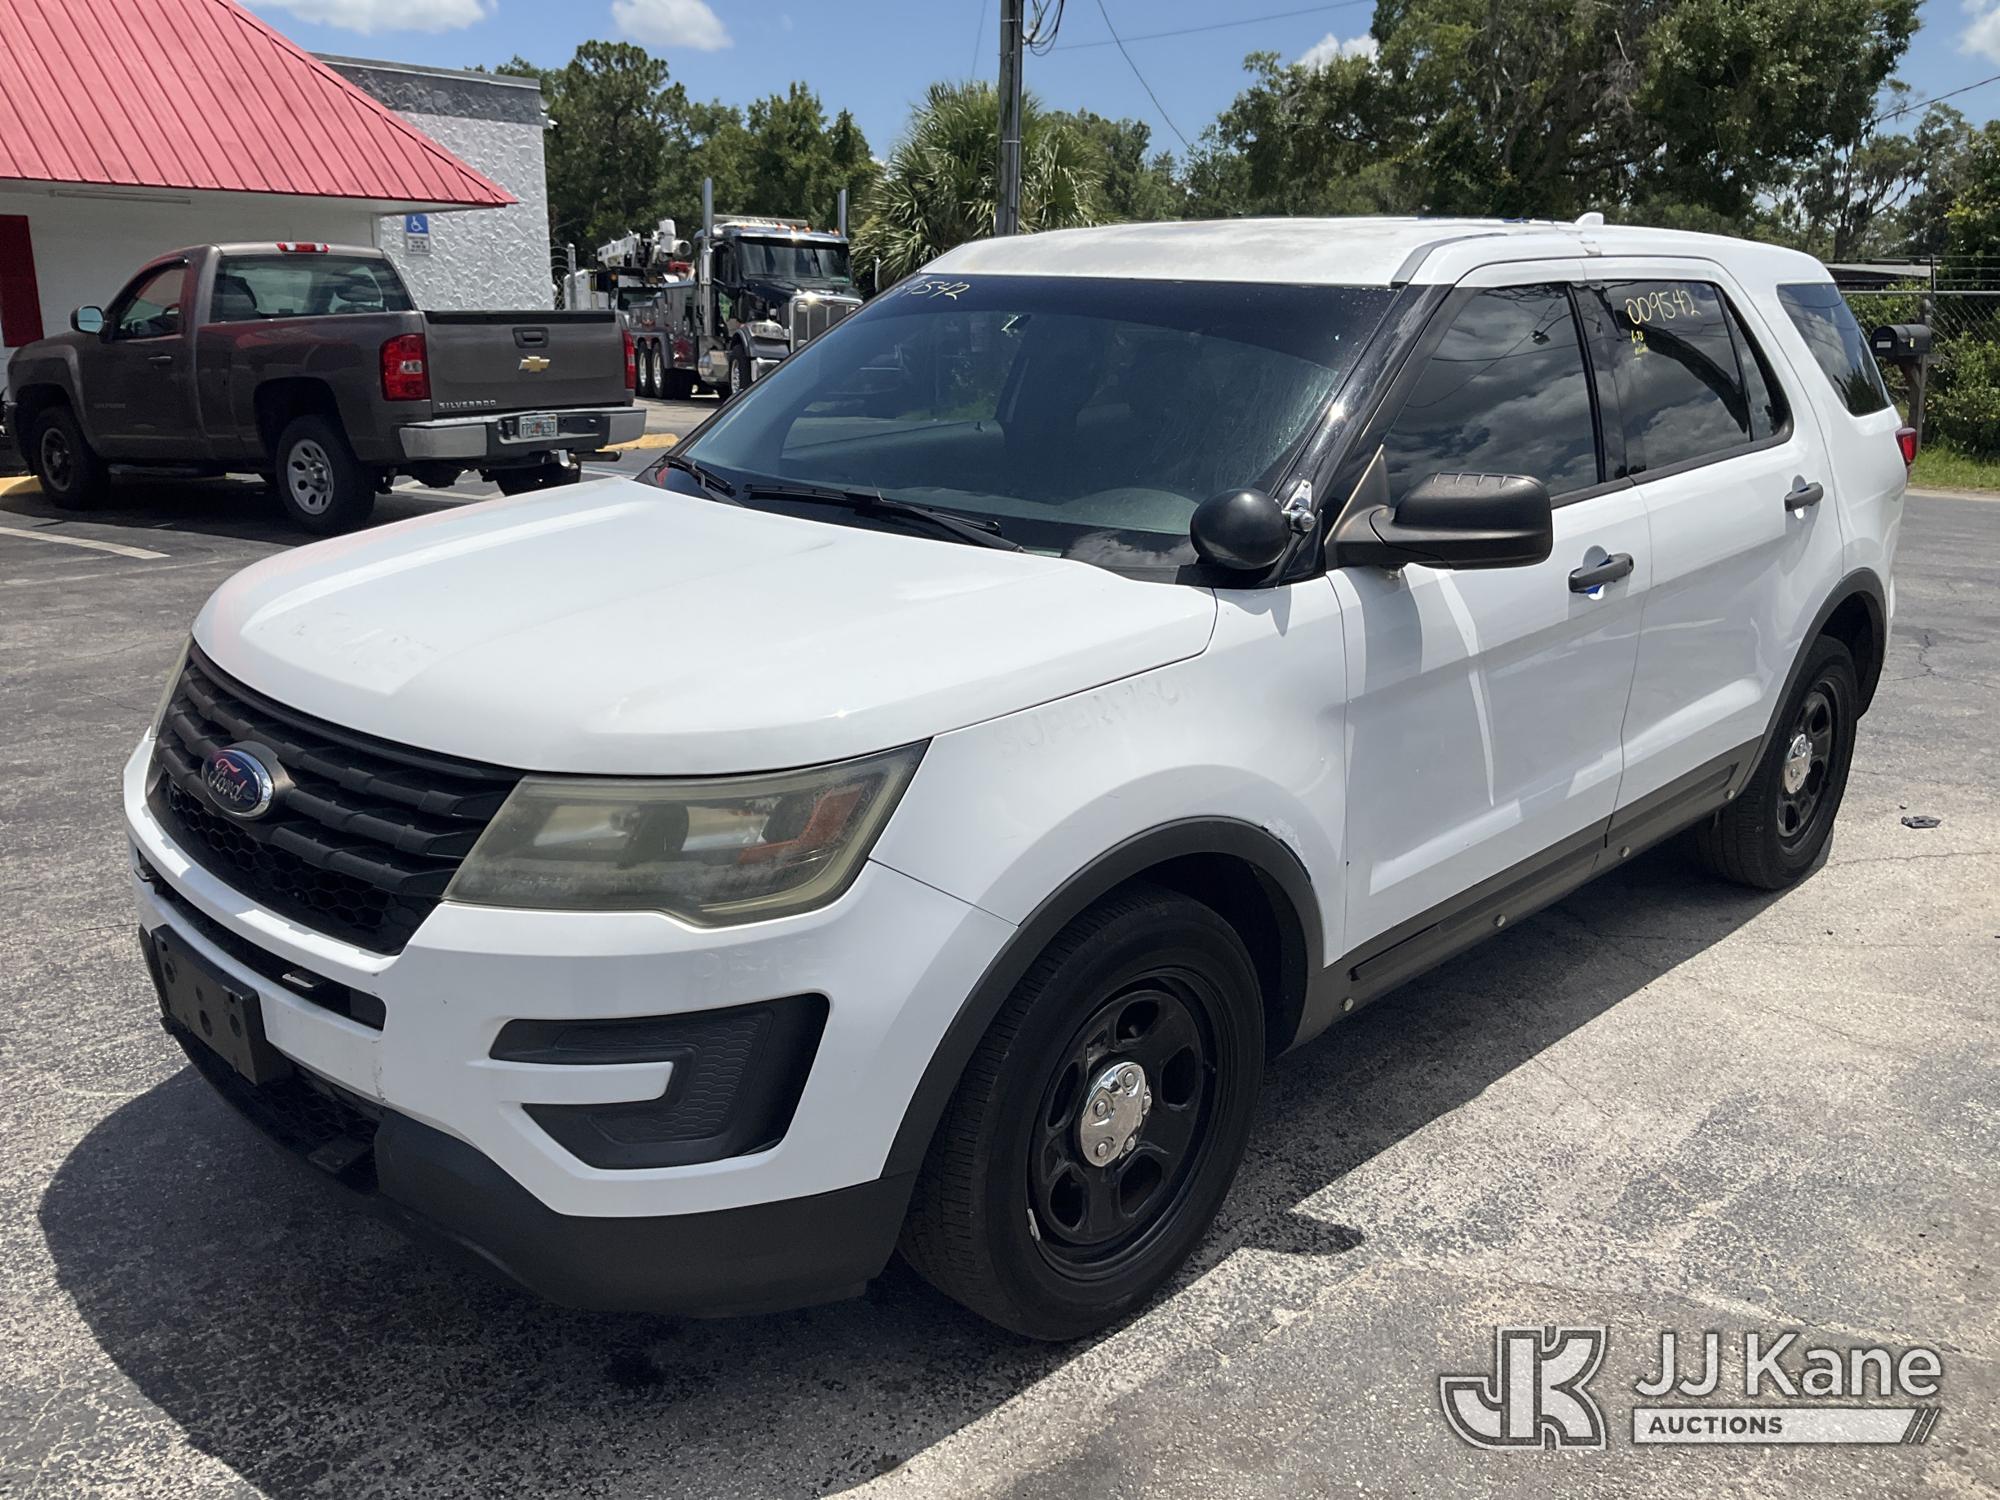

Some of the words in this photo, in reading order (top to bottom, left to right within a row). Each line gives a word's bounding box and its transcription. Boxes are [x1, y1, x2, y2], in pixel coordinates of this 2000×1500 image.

[1625, 288, 1702, 325] 009542
[439, 399, 497, 410] SILVERADO
[207, 758, 248, 802] Ford
